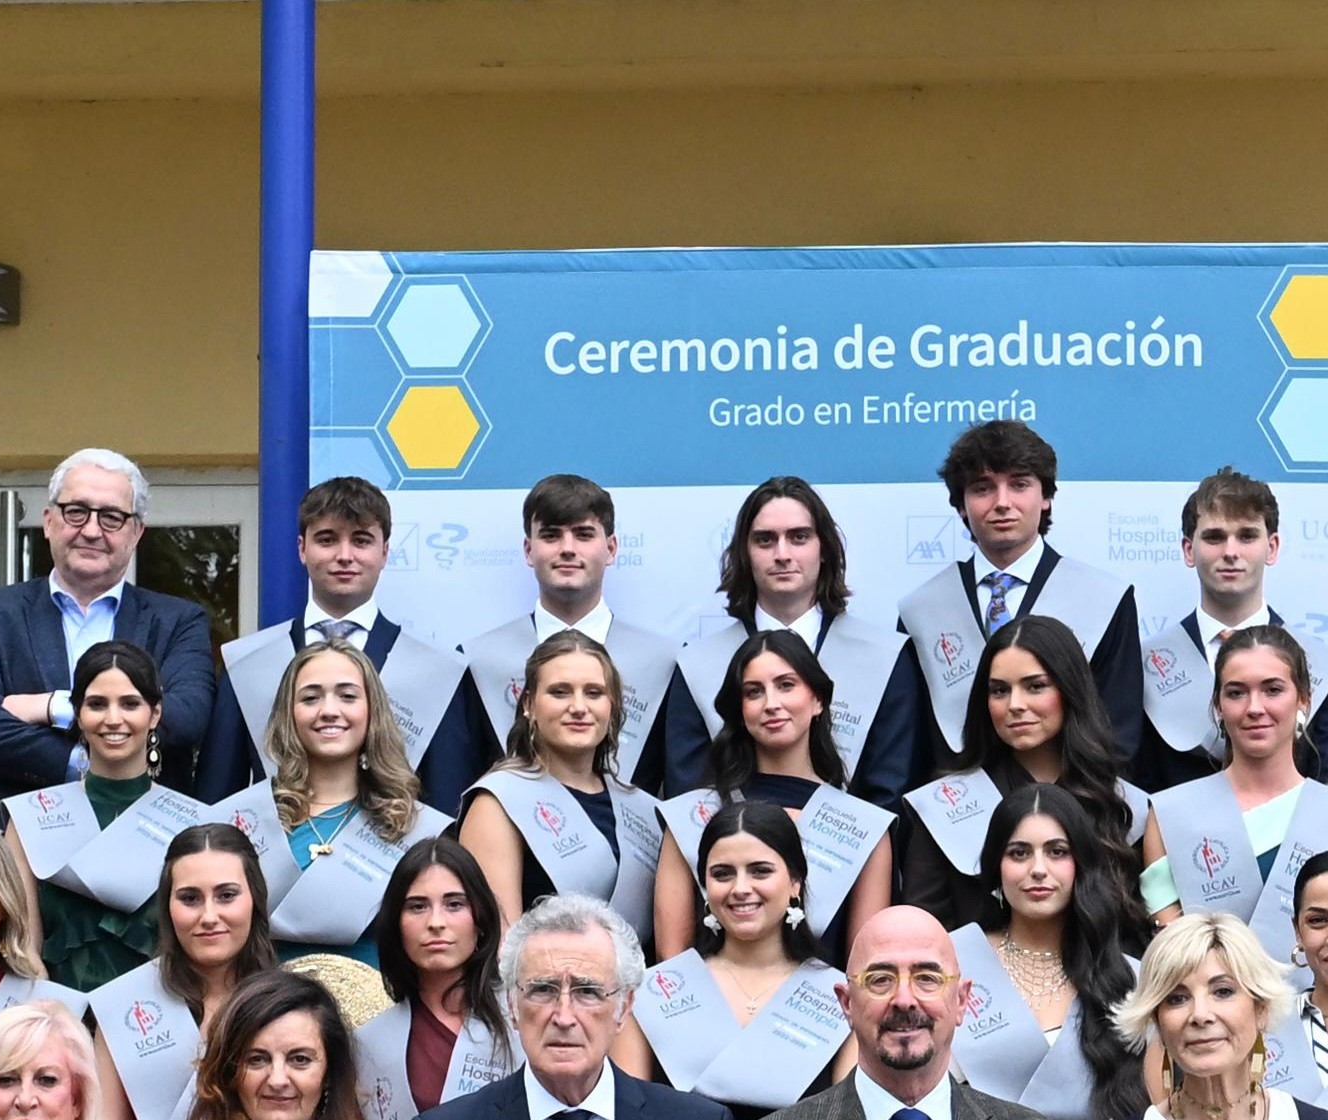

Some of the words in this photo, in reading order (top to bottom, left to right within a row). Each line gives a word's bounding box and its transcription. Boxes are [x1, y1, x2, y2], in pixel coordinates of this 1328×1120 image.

[544, 325, 819, 376] Ceremonia
[833, 323, 896, 371] de
[909, 315, 1204, 368] Graduación
[708, 395, 805, 427] Grado
[813, 402, 852, 425] en
[863, 389, 1037, 425] Enfermería
[1108, 512, 1159, 525] Escuela
[1108, 527, 1180, 544] Hospital
[907, 540, 946, 559] AXA
[1108, 544, 1181, 563] Mompía
[943, 659, 971, 681] UCAV
[1156, 670, 1187, 691] UCAV
[37, 812, 71, 825] UCAV
[946, 799, 980, 820] UCAV
[808, 818, 861, 851] Mompía
[814, 808, 870, 841] Hospital
[552, 832, 582, 851] UCAV
[1201, 875, 1236, 894] UCAV
[660, 993, 696, 1014] UCAV
[784, 995, 840, 1030] Mompía
[967, 1011, 1004, 1034] UCAV
[134, 1029, 171, 1051] UCAV
[1264, 1065, 1290, 1083] CAV
